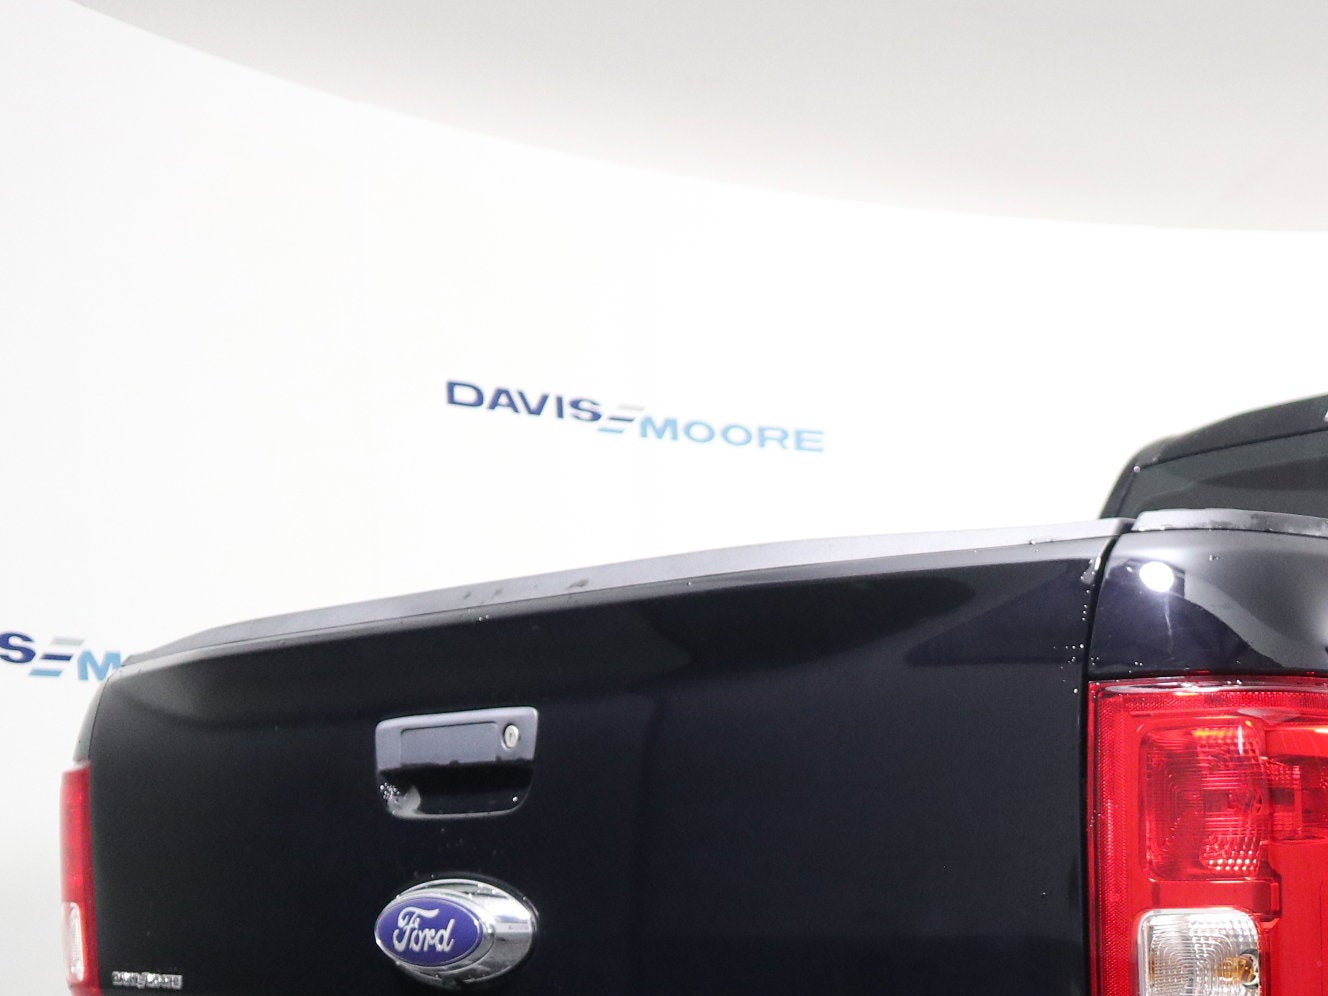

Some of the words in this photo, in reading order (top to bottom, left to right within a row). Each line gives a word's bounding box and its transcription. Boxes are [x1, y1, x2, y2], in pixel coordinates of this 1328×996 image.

[446, 380, 602, 422] DAVIS
[639, 415, 824, 452] MOORE
[392, 906, 456, 953] Ford
